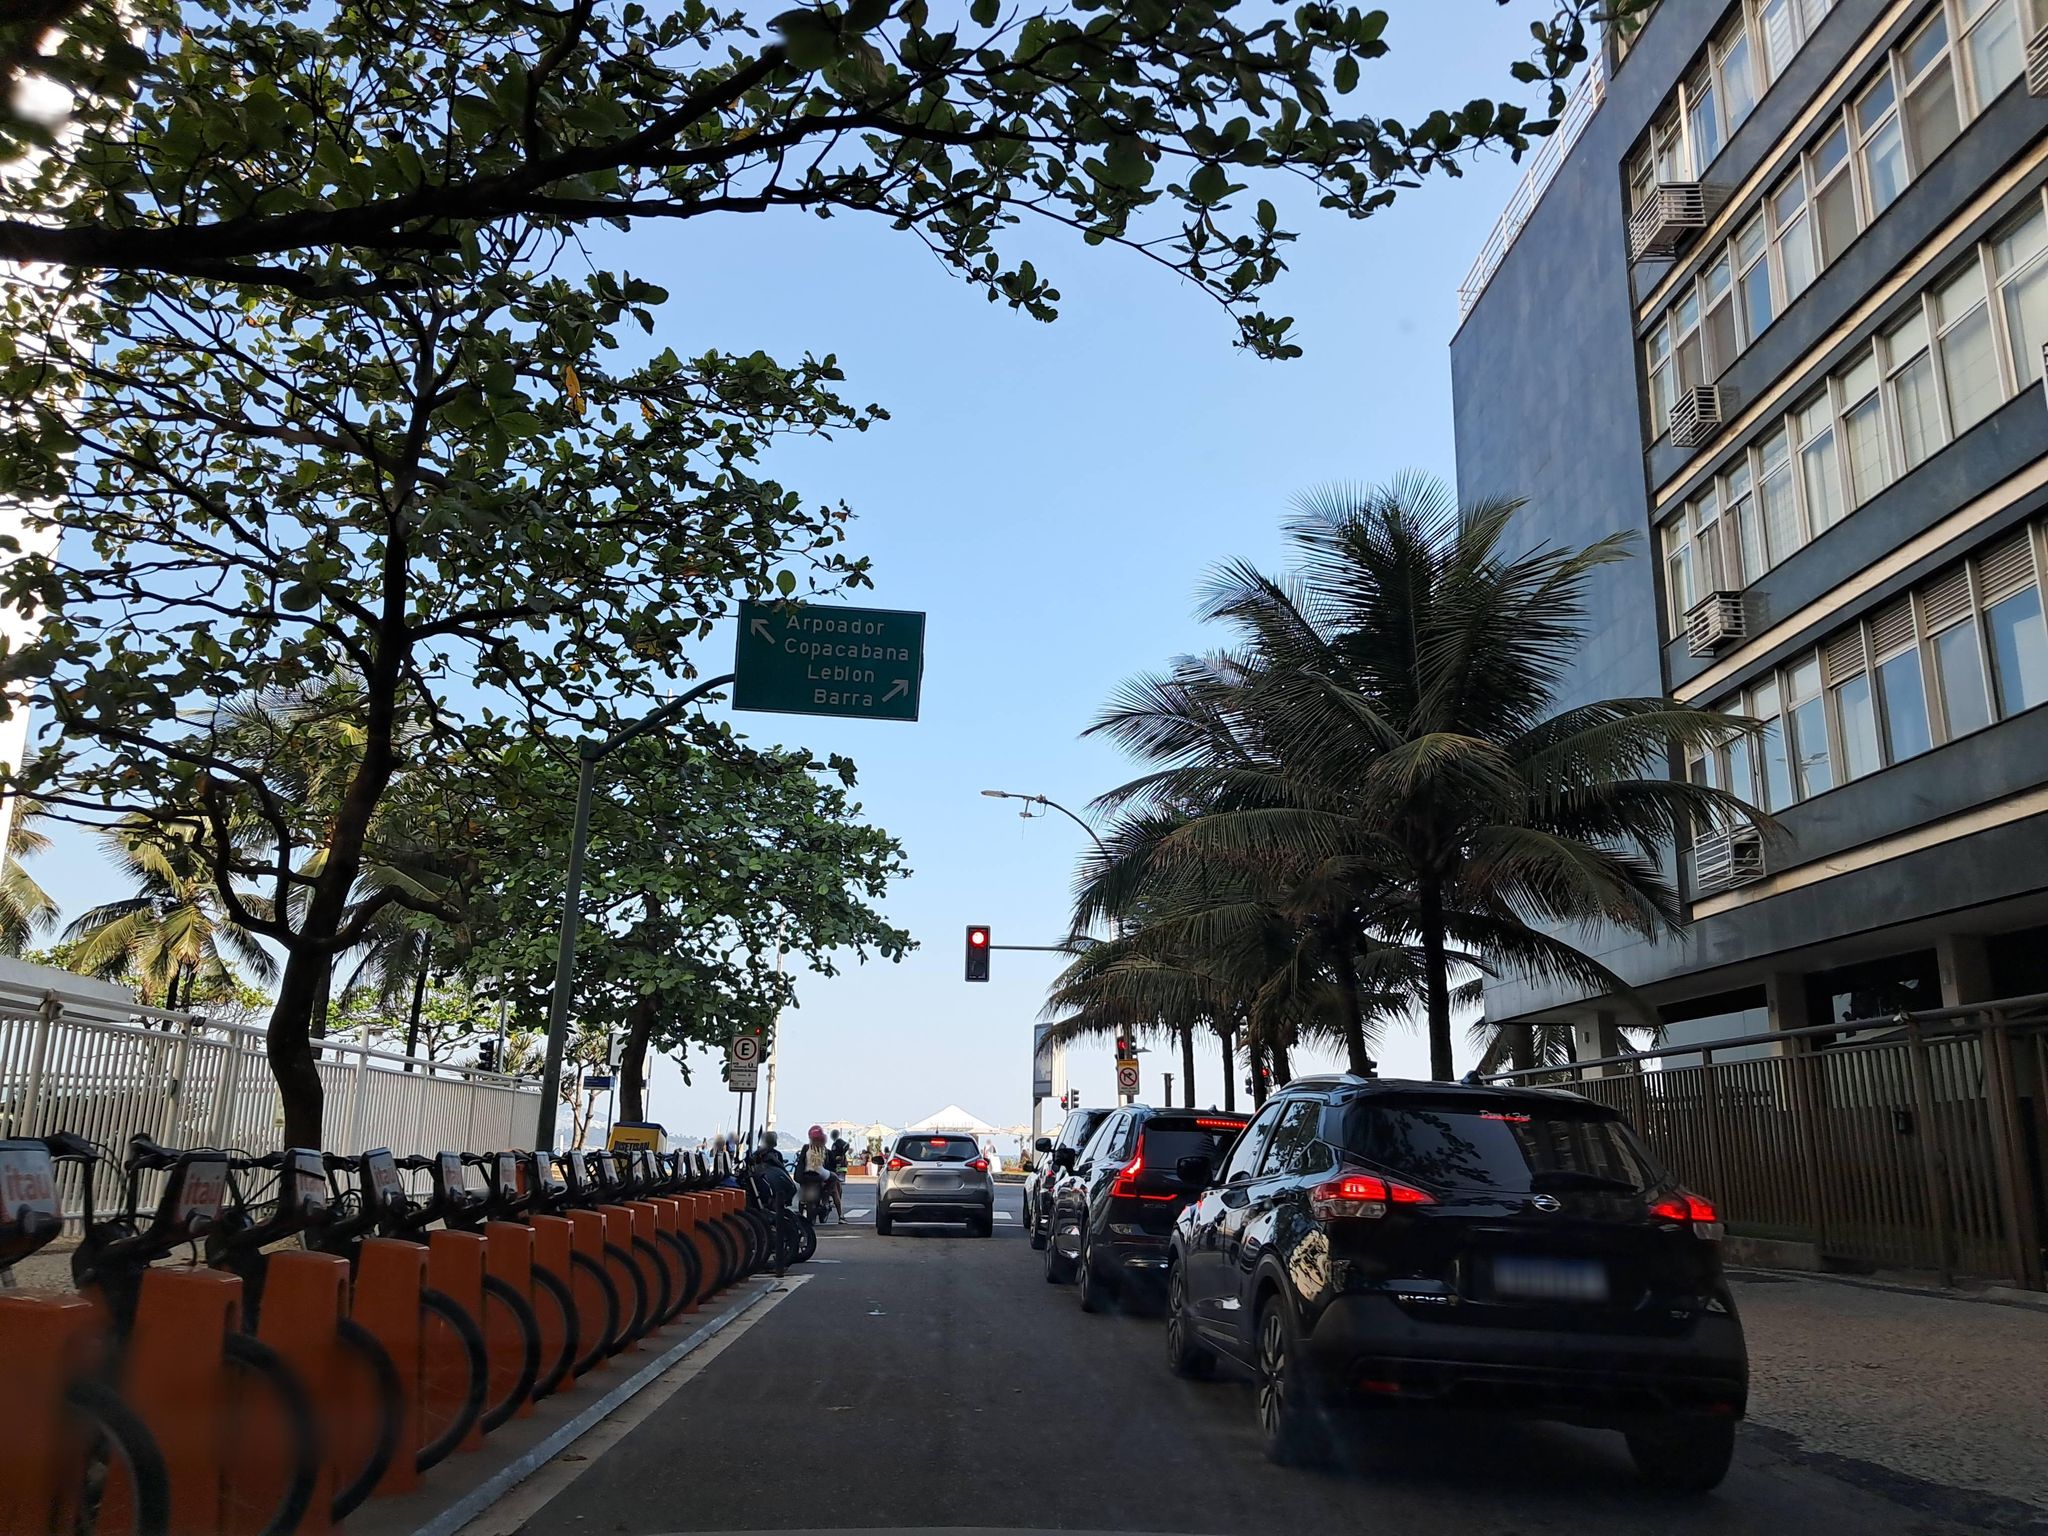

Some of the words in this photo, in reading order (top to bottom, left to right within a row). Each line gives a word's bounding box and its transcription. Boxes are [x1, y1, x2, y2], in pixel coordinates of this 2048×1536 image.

[785, 615, 885, 636] Arpoador
[784, 638, 909, 661] Copacabana
[807, 664, 875, 683] Leblon
[813, 688, 873, 707] Barra
[741, 1043, 750, 1056] E
